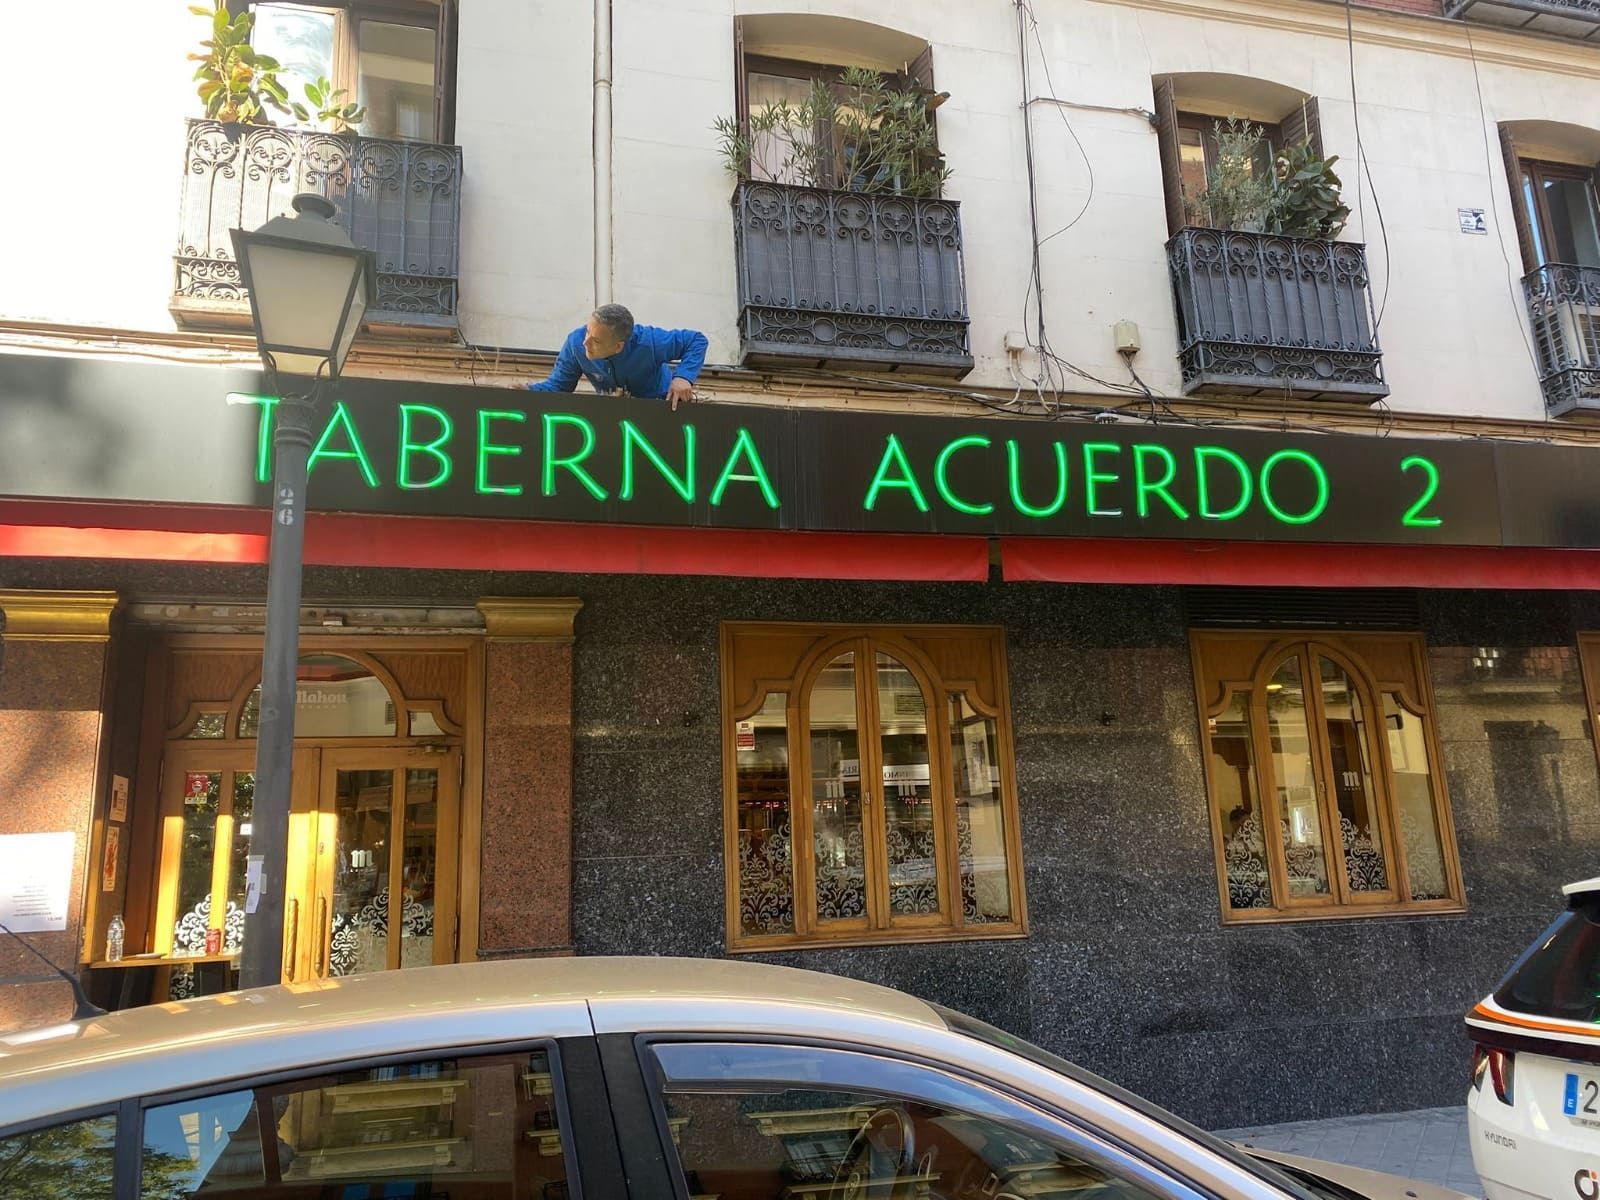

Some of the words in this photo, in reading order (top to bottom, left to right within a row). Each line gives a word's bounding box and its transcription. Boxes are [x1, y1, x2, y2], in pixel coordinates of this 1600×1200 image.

[226, 394, 782, 509] TABERNA
[863, 433, 1330, 525] ACUERDO
[1400, 456, 1442, 527] 2
[1483, 1129, 1518, 1151] HYUNDAI
